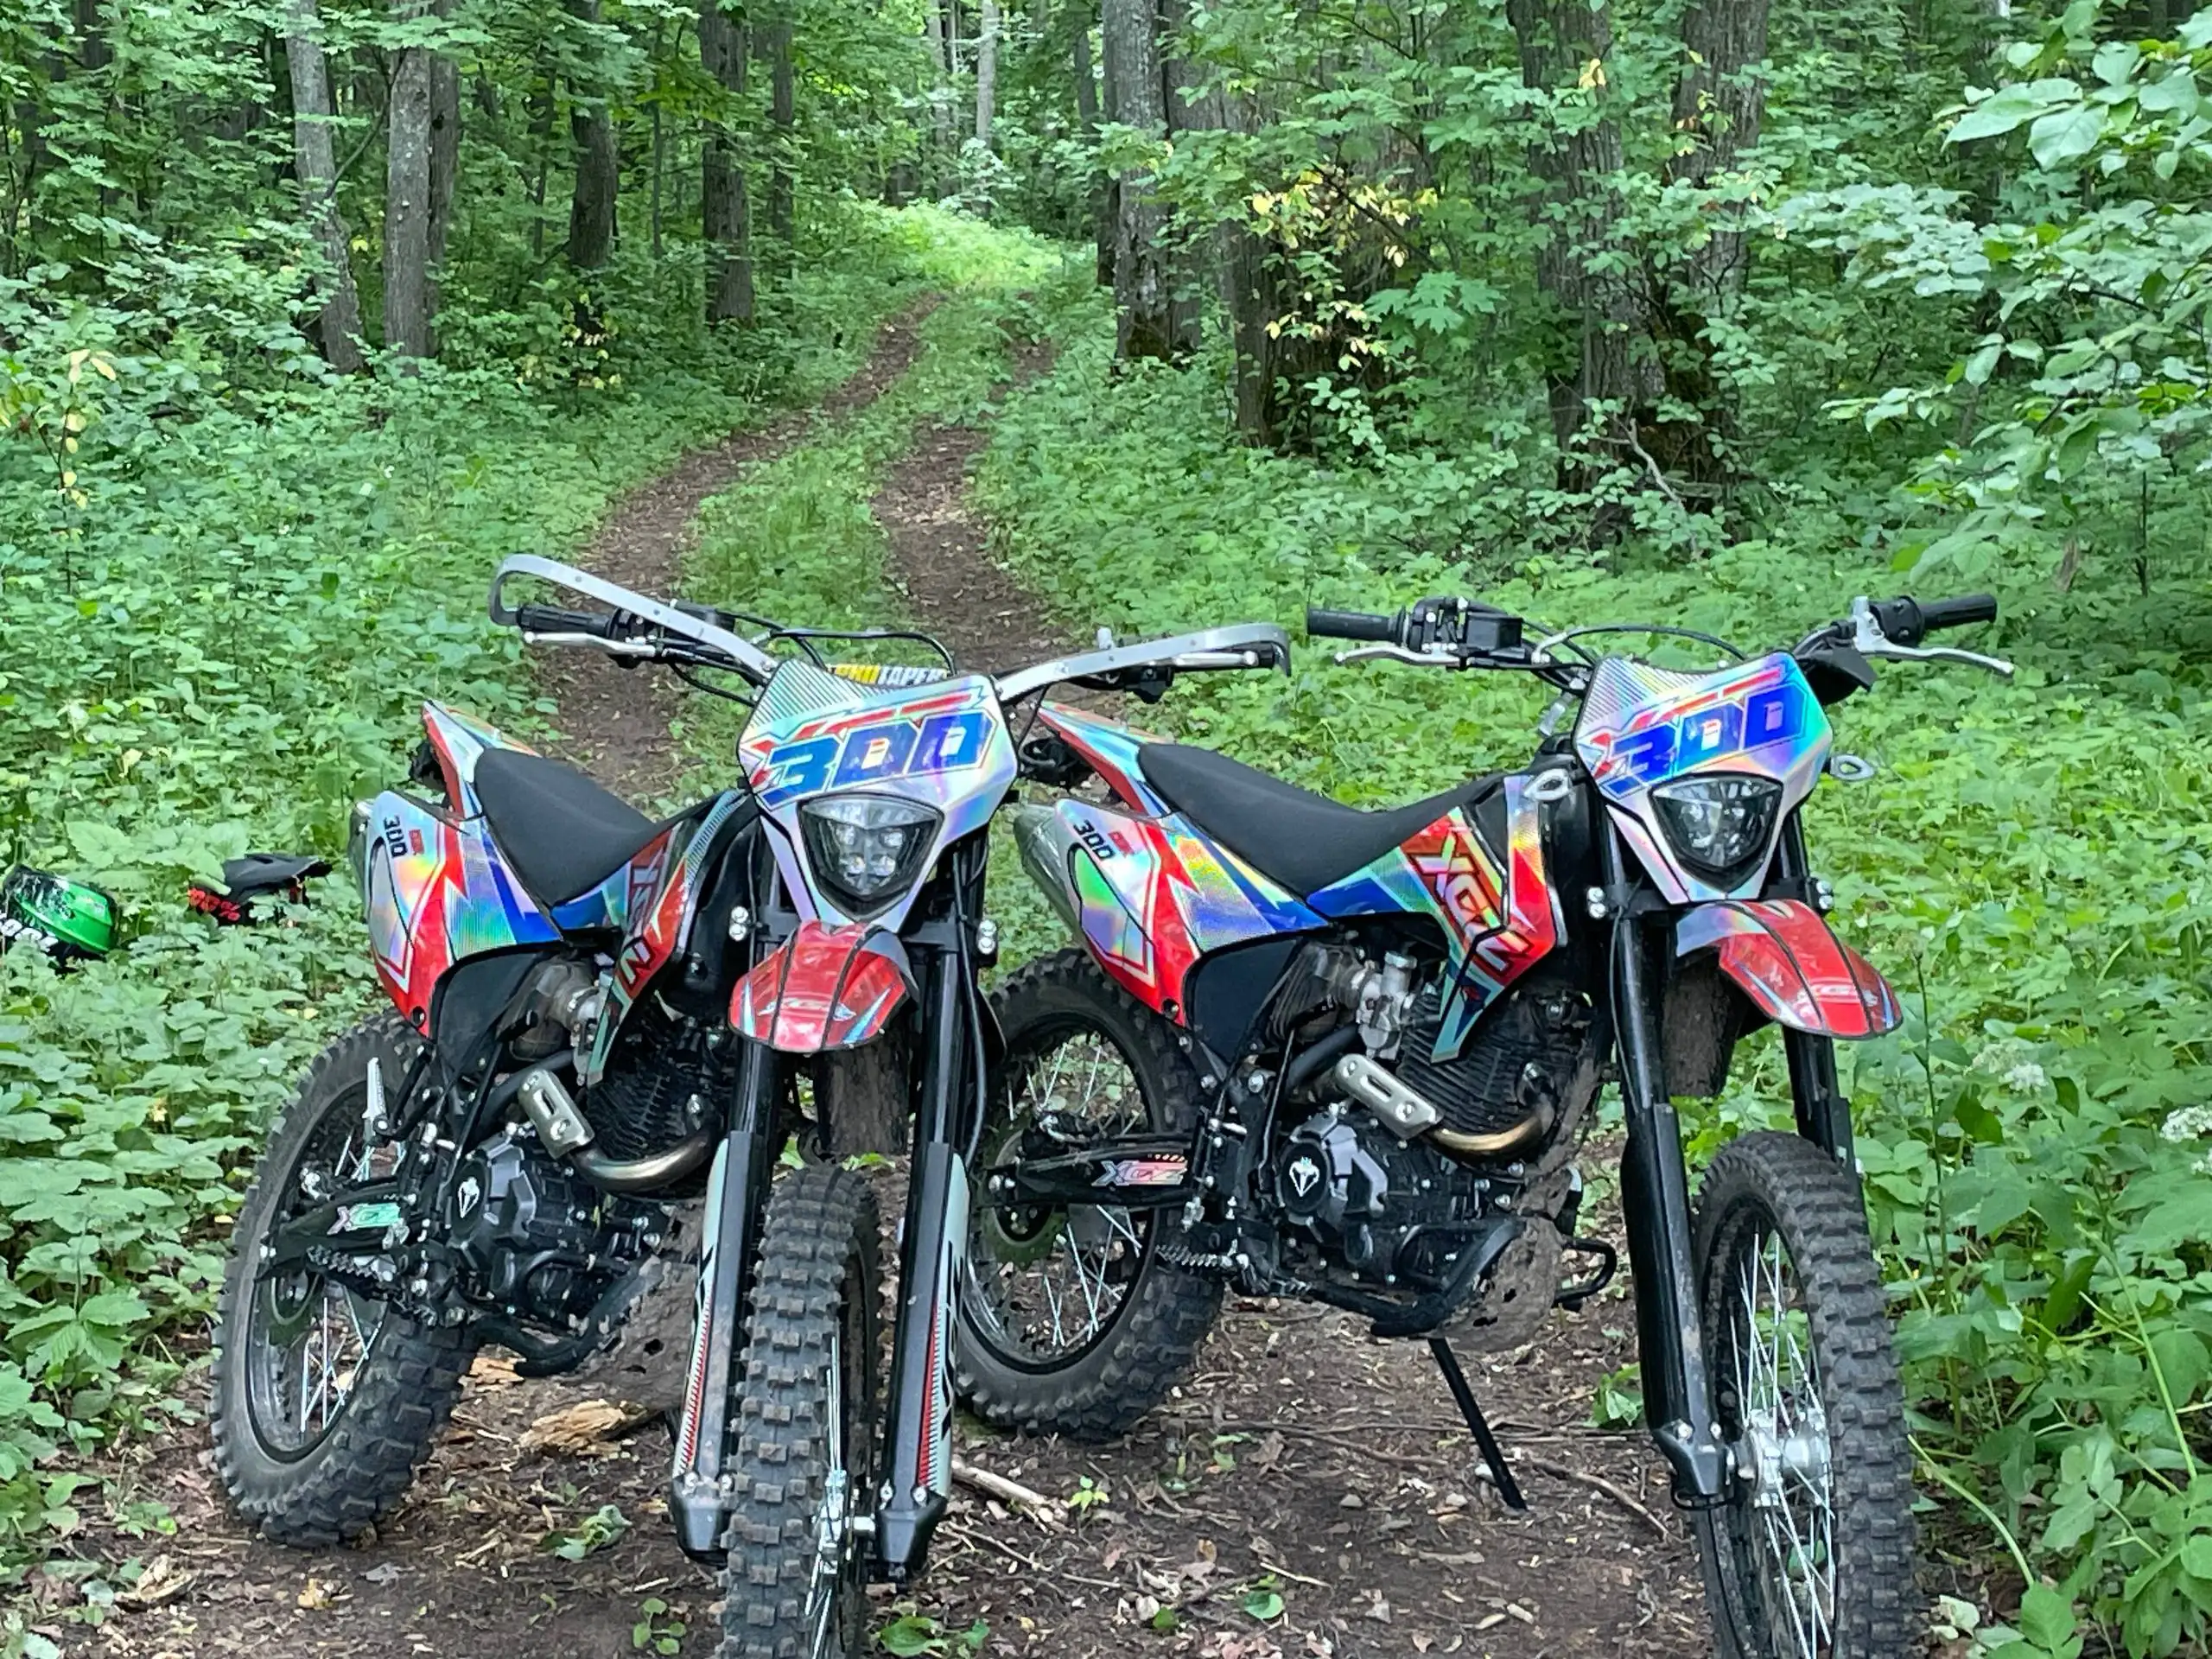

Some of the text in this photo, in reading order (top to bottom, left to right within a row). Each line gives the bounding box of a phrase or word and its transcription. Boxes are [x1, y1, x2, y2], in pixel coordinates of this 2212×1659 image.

[760, 710, 995, 809] 300
[1601, 682, 1807, 798] 300
[384, 815, 408, 857] 300
[1073, 820, 1116, 861] 300
